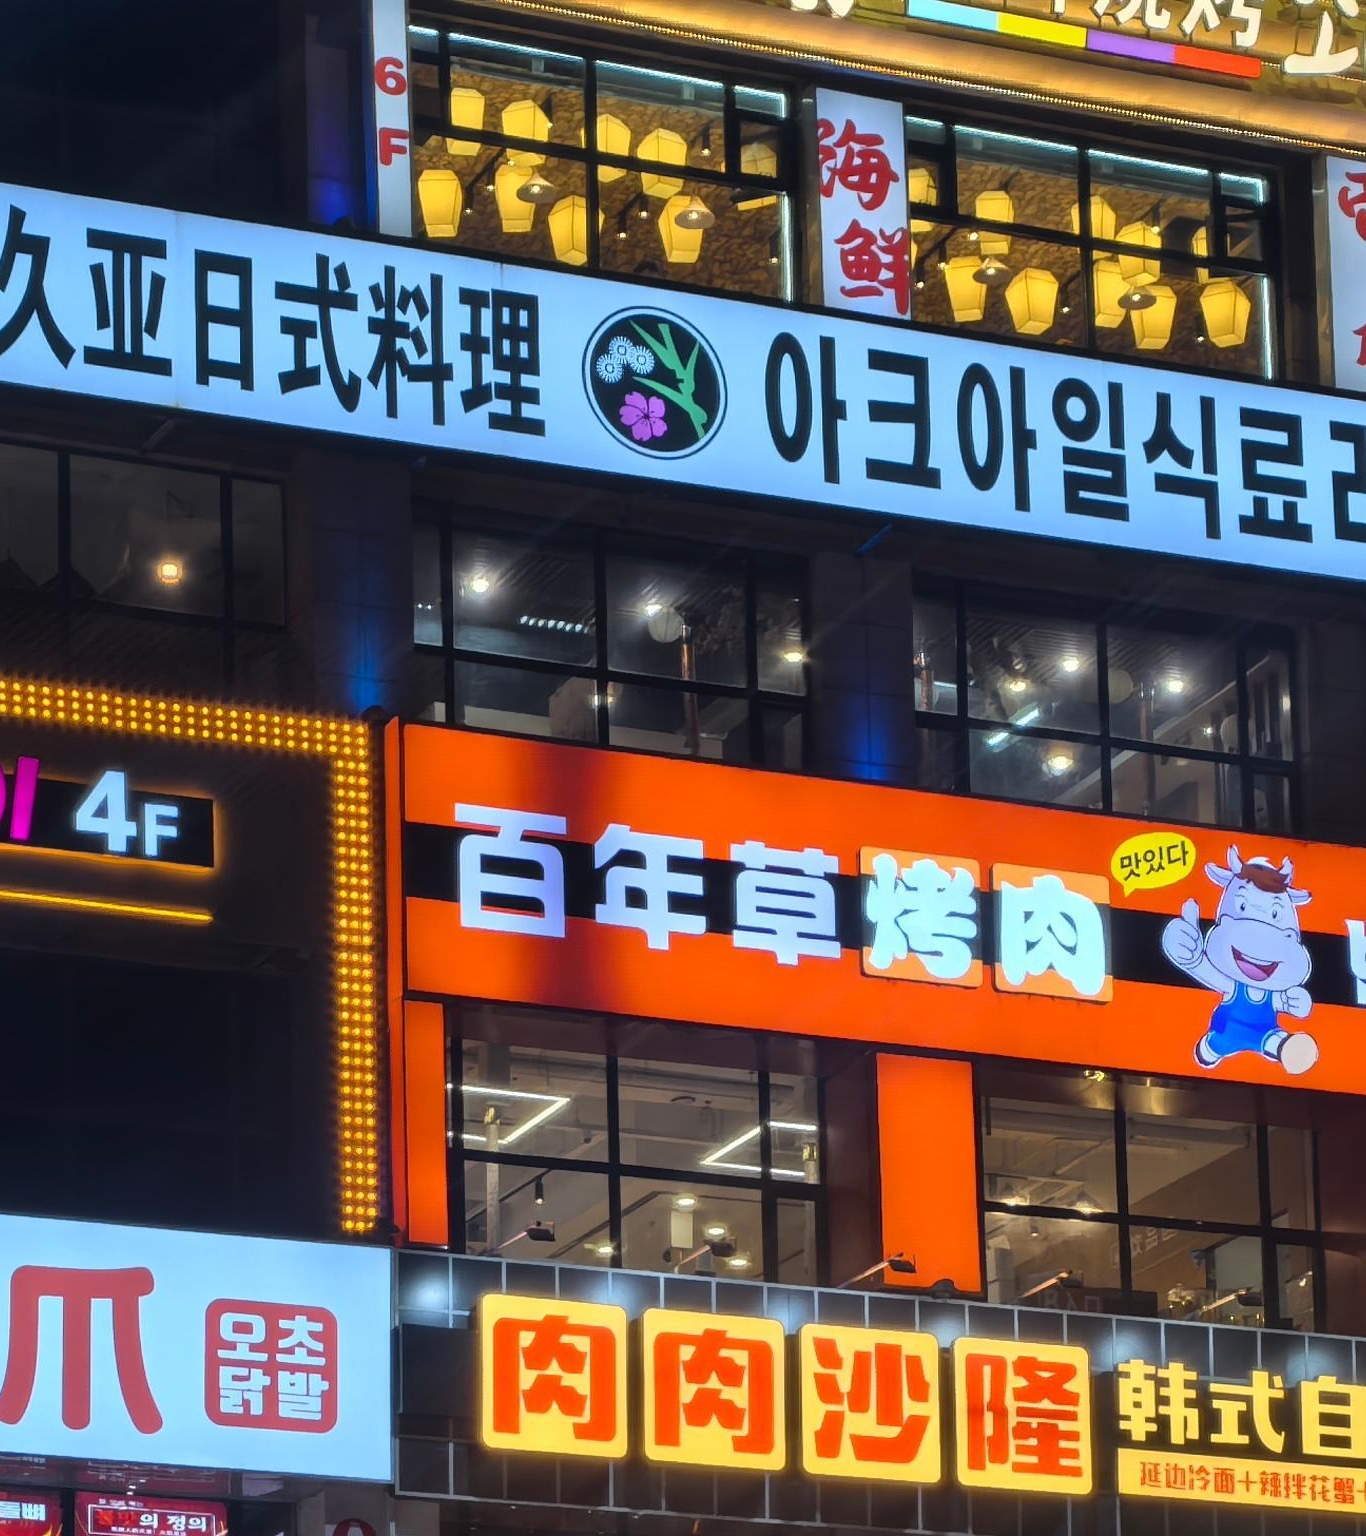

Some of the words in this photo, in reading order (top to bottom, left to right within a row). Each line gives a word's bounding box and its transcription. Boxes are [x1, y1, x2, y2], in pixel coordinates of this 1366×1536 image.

[817, 118, 911, 316] 海鲜
[73, 770, 179, 857] 4F
[453, 803, 1107, 997] 百年草烤肉
[1118, 840, 1190, 881] 맛있다
[216, 1312, 329, 1369] 오초
[216, 1364, 329, 1422] 닭발
[491, 1313, 1084, 1481] 肉肉沙隆
